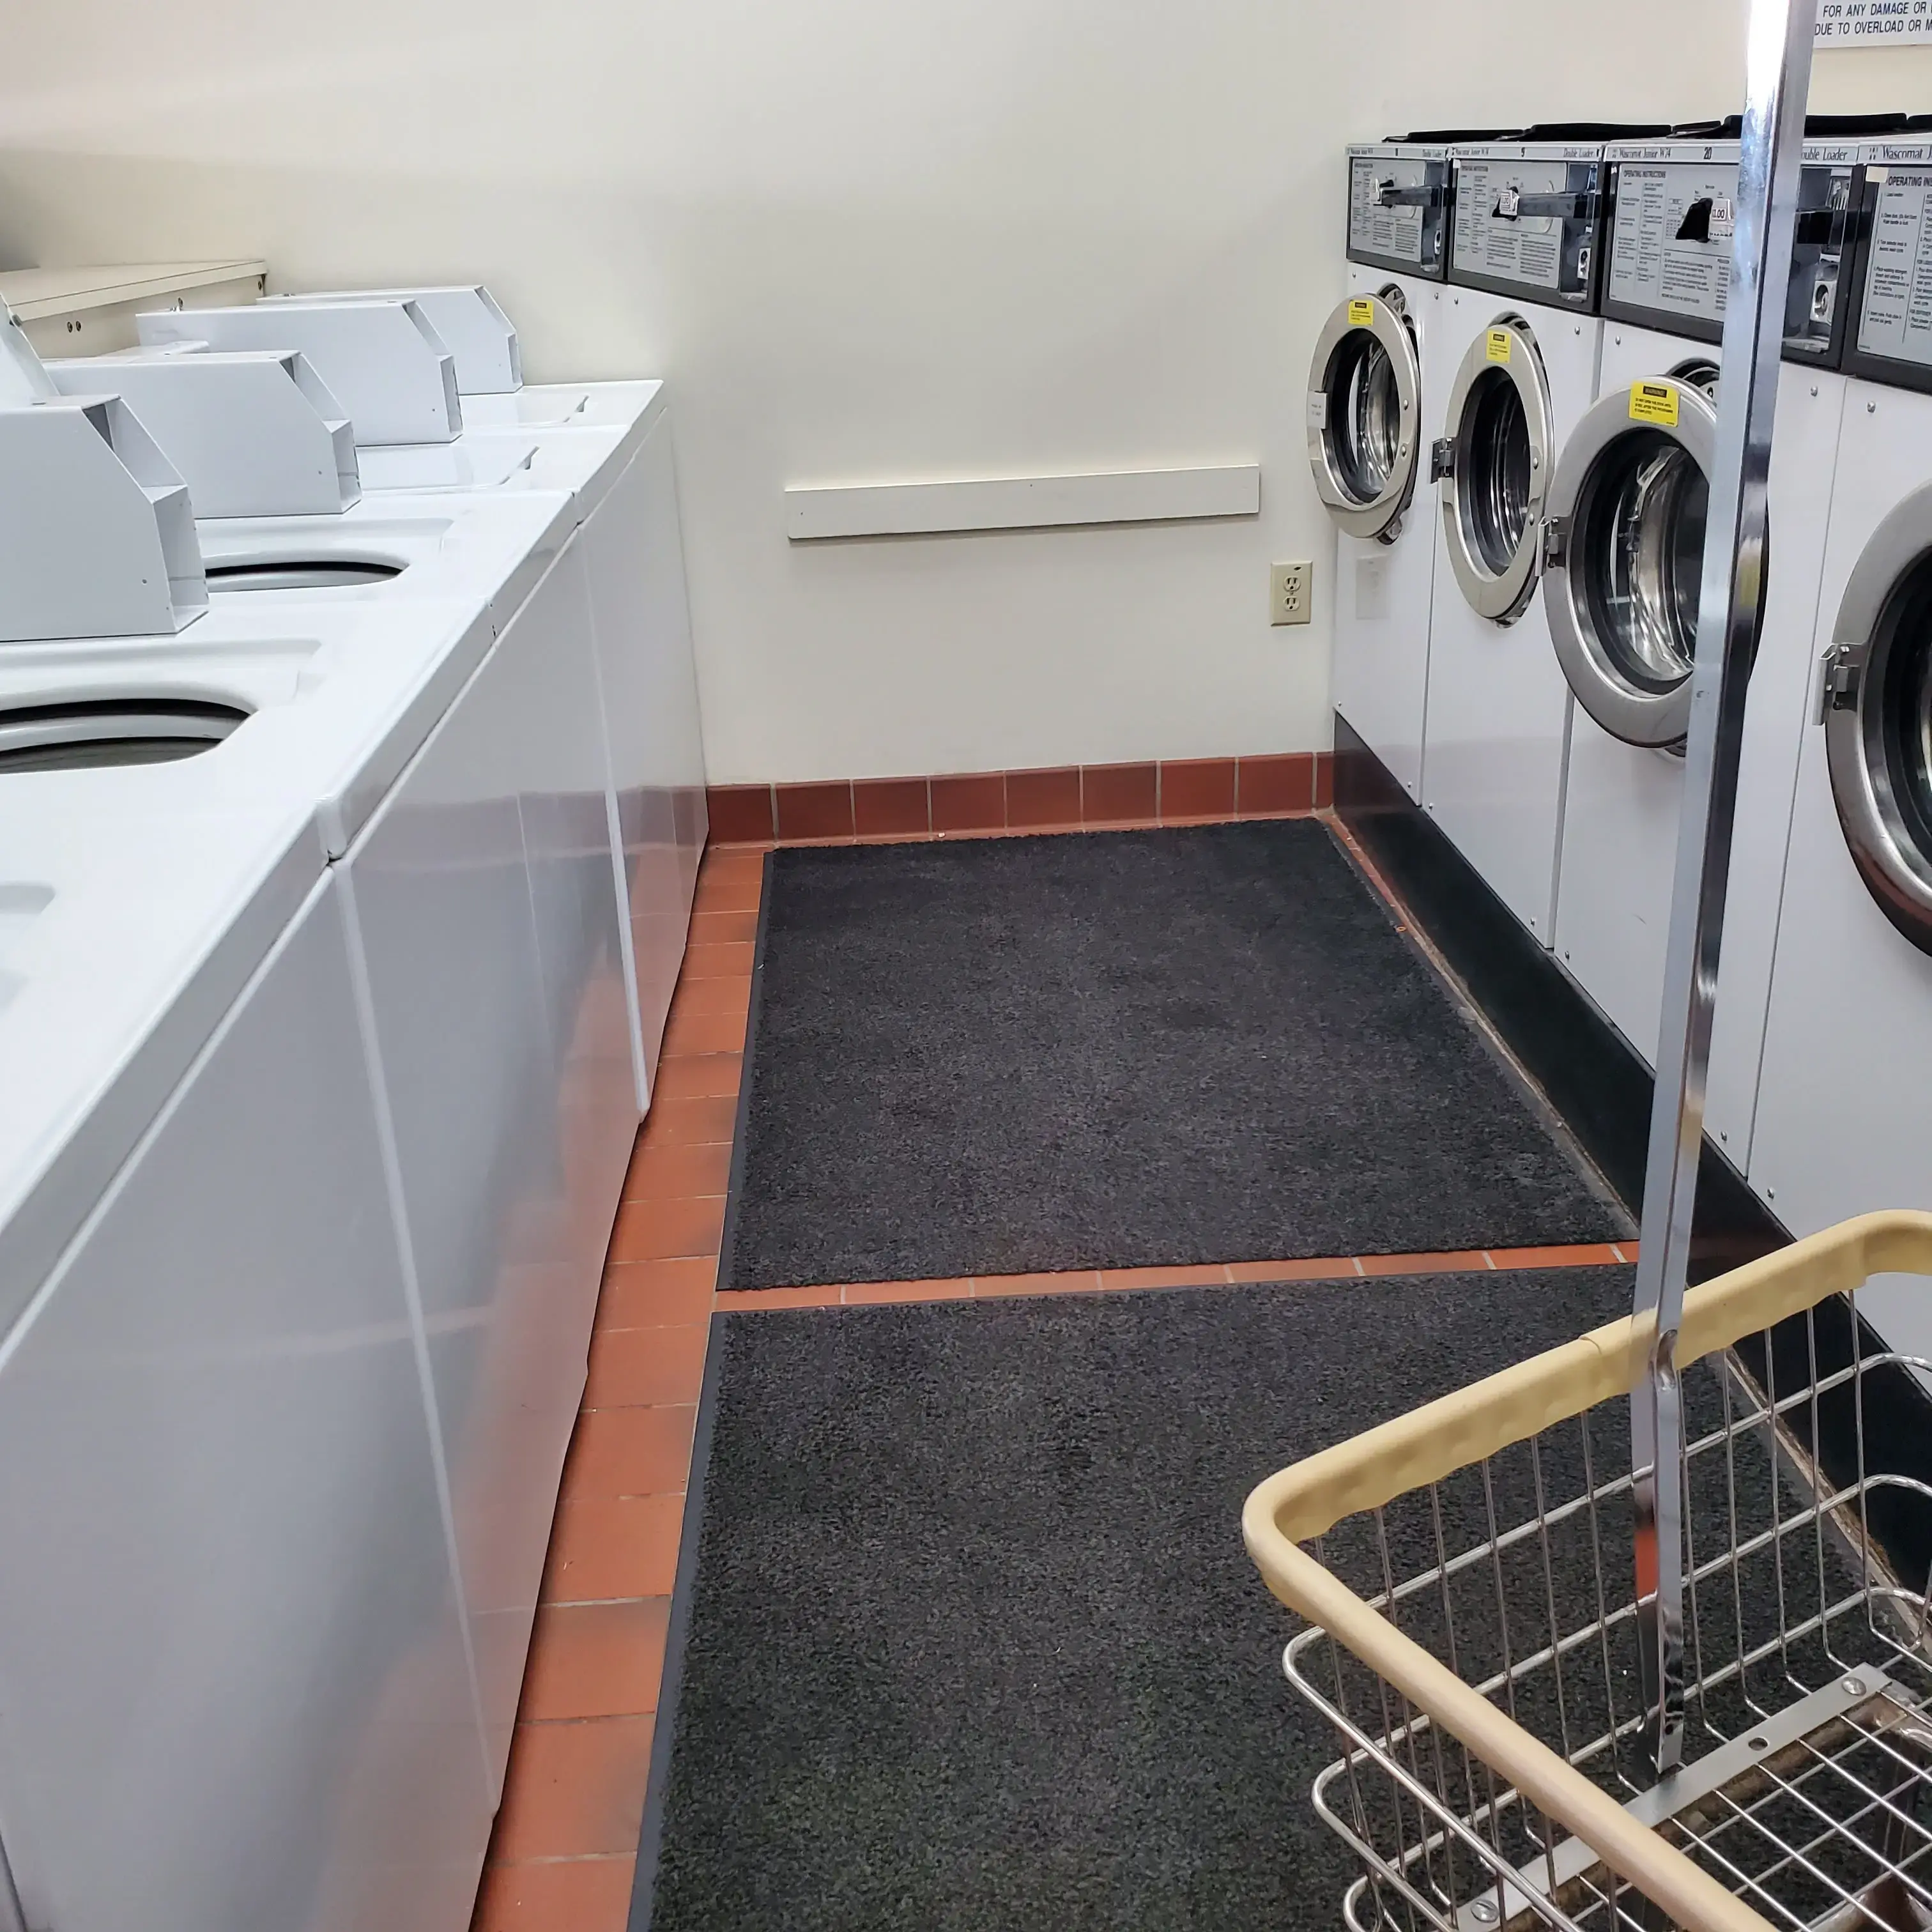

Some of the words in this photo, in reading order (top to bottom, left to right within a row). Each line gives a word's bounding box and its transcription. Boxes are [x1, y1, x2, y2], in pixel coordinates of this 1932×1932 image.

[1823, 5, 1841, 17] FOR
[1846, 4, 1866, 17] ANY
[1870, 2, 1909, 16] DAMAGE
[1913, 1, 1926, 14] OR
[1814, 22, 1833, 36] DUE
[1838, 22, 1850, 34] TO
[1854, 20, 1904, 34] OVERLOAD
[1908, 19, 1921, 32] OR
[1703, 146, 1712, 160] 20
[1801, 148, 1820, 160] ouble
[1822, 147, 1848, 161] Loader
[1882, 145, 1923, 160] Wascomat
[1888, 176, 1922, 187] OPERATING
